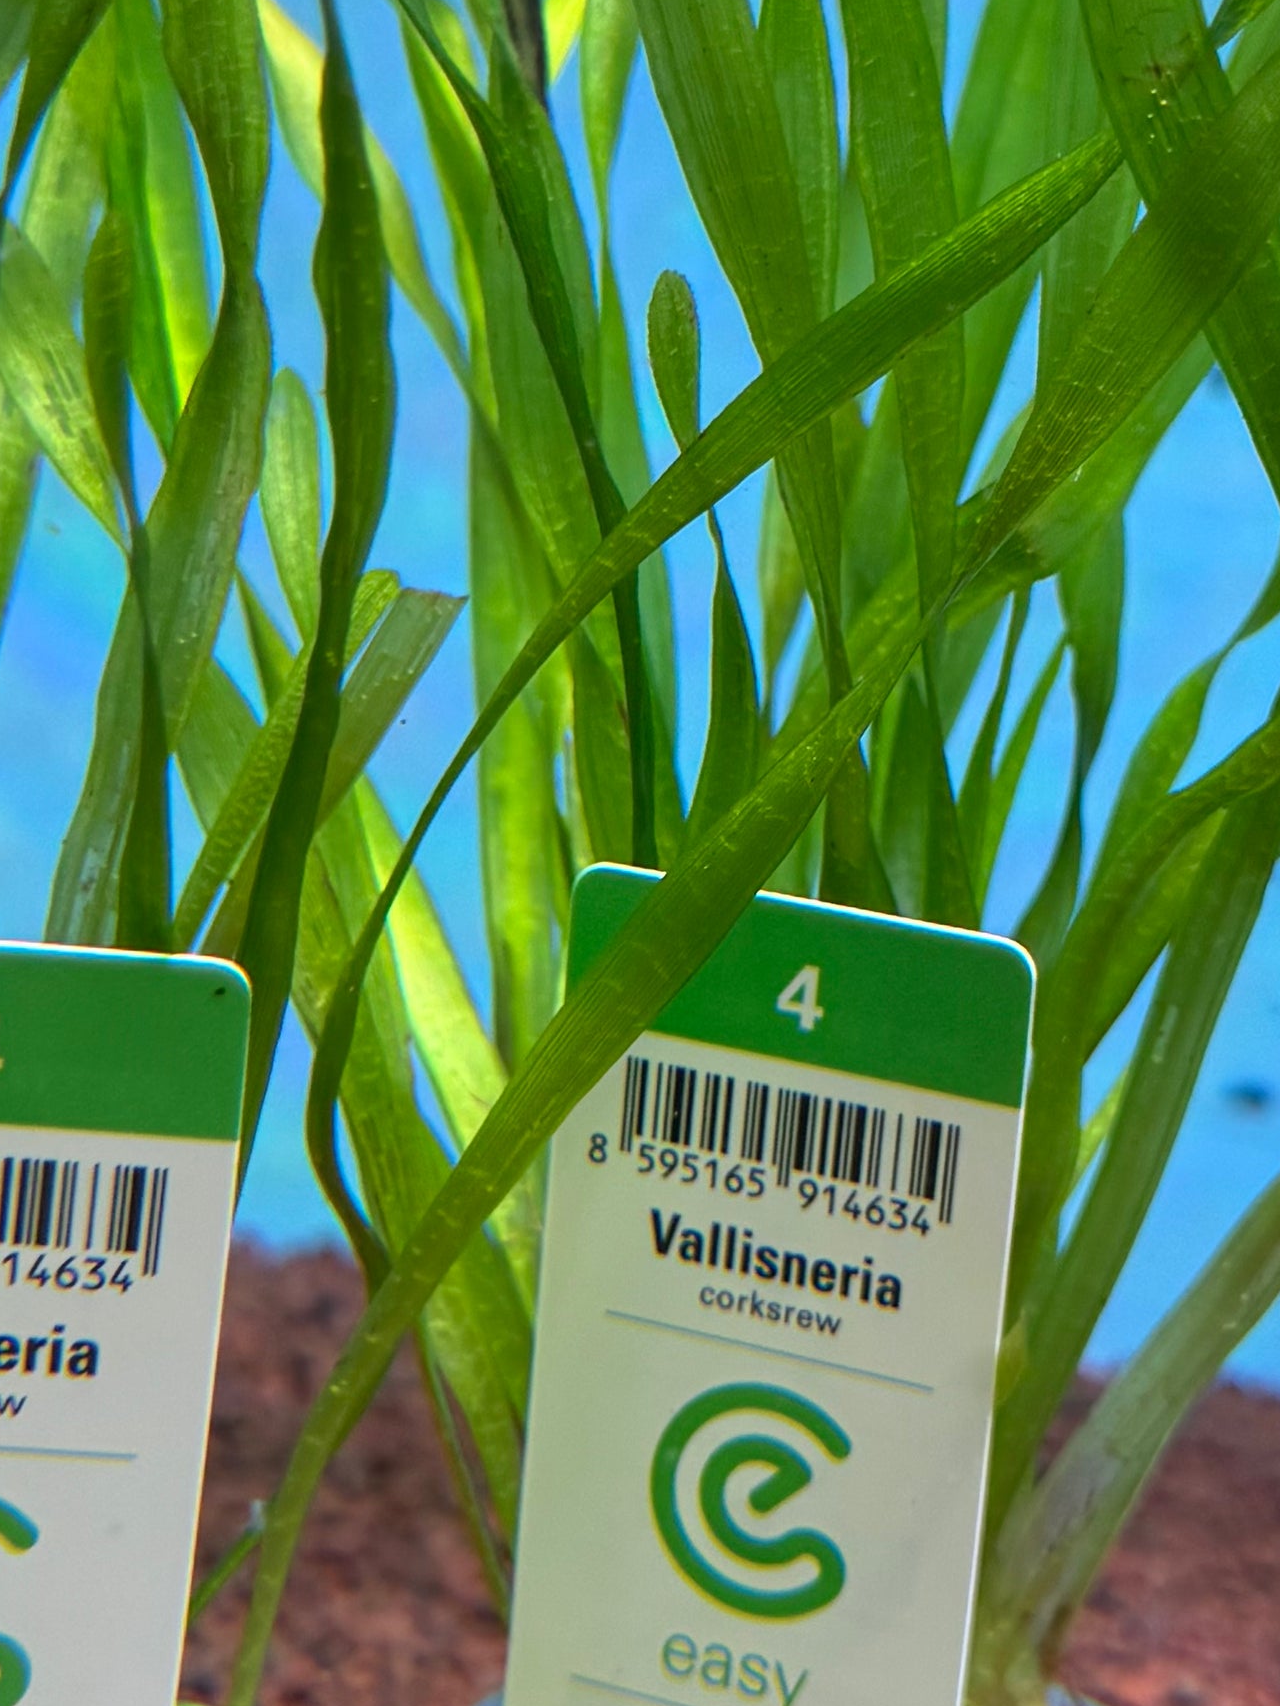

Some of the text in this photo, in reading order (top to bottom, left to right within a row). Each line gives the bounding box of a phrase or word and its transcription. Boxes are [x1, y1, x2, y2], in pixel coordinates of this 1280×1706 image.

[776, 964, 824, 1033] 4
[588, 1133, 931, 1237] 8 595165 914634
[649, 1208, 902, 1310] Vallisneria
[699, 1284, 842, 1336] corksrew
